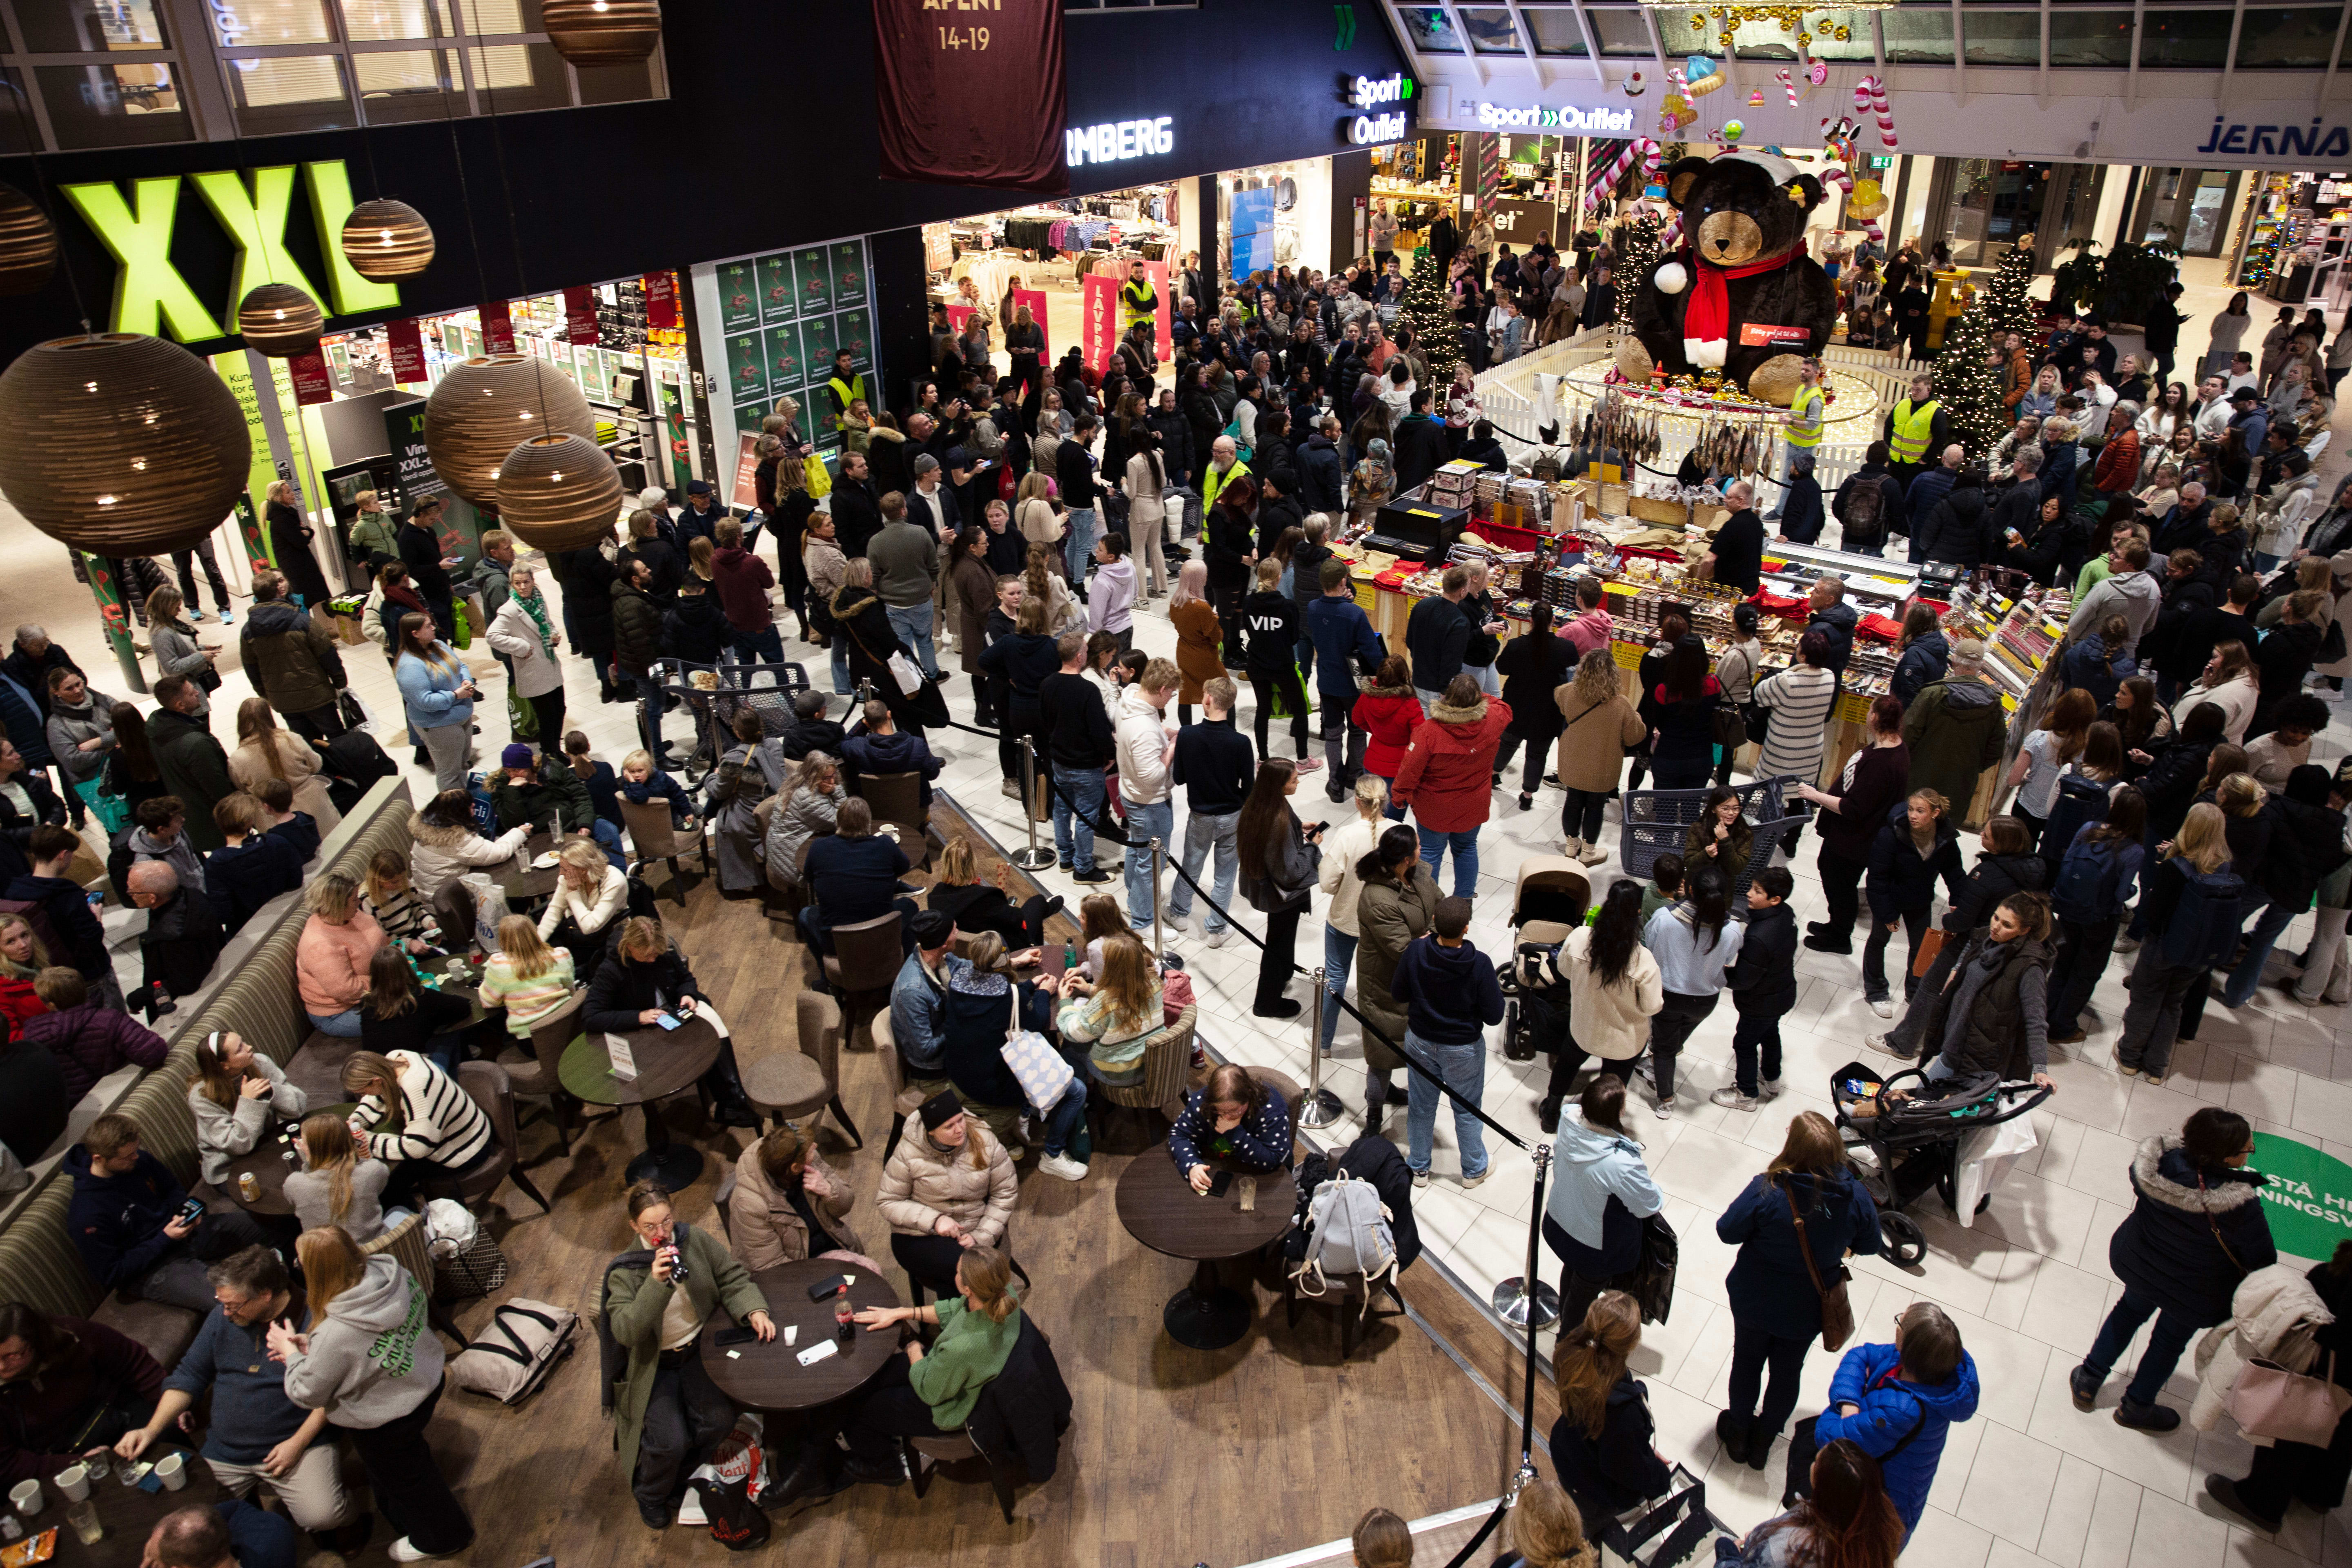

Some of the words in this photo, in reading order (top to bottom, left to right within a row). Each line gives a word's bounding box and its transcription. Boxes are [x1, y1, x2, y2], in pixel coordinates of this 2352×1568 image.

[939, 27, 990, 50] 14-19
[1356, 73, 1402, 110] Sport
[1354, 111, 1405, 145] Outlet
[1479, 102, 1541, 129] Sport
[1559, 105, 1633, 131] Outlet
[1562, 151, 1571, 172] utlet
[1494, 210, 1516, 231] et
[57, 158, 401, 343] XXL
[1092, 285, 1104, 371] LAVPRIS
[1250, 615, 1283, 631] VIP
[473, 805, 487, 818] rli
[2265, 1173, 2314, 1199] STÅ
[2256, 1185, 2352, 1228] NINGSV
[380, 1339, 405, 1369] CAVA
